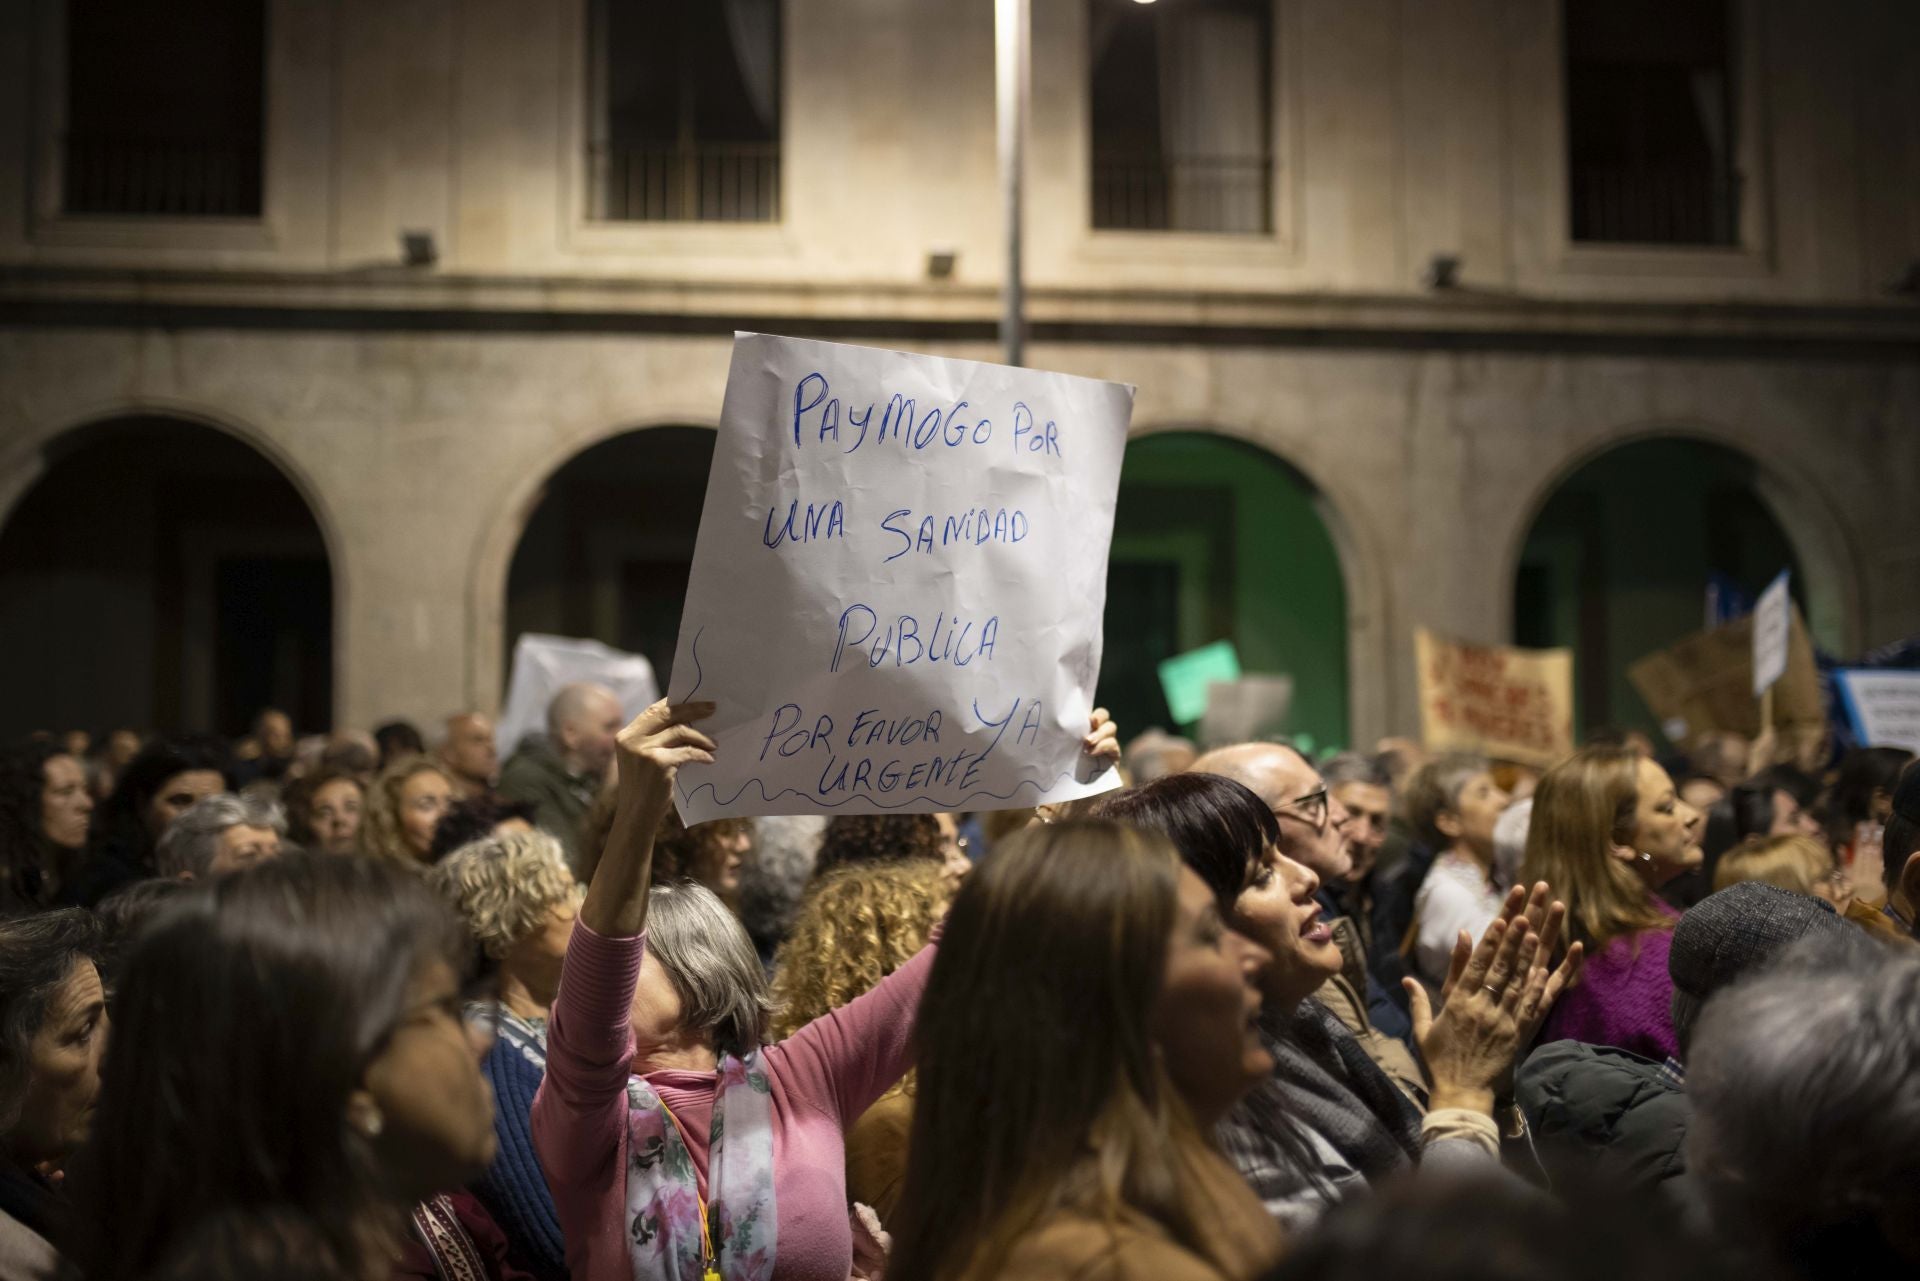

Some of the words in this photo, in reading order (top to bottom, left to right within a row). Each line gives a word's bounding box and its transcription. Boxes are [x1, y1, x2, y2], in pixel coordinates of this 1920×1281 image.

[794, 372, 992, 453] PAYMOGO
[763, 499, 844, 549] UNA
[760, 703, 834, 761] POR
[848, 709, 942, 746] FAVOR
[973, 697, 1042, 762] YA
[818, 748, 985, 795] URGENTE
